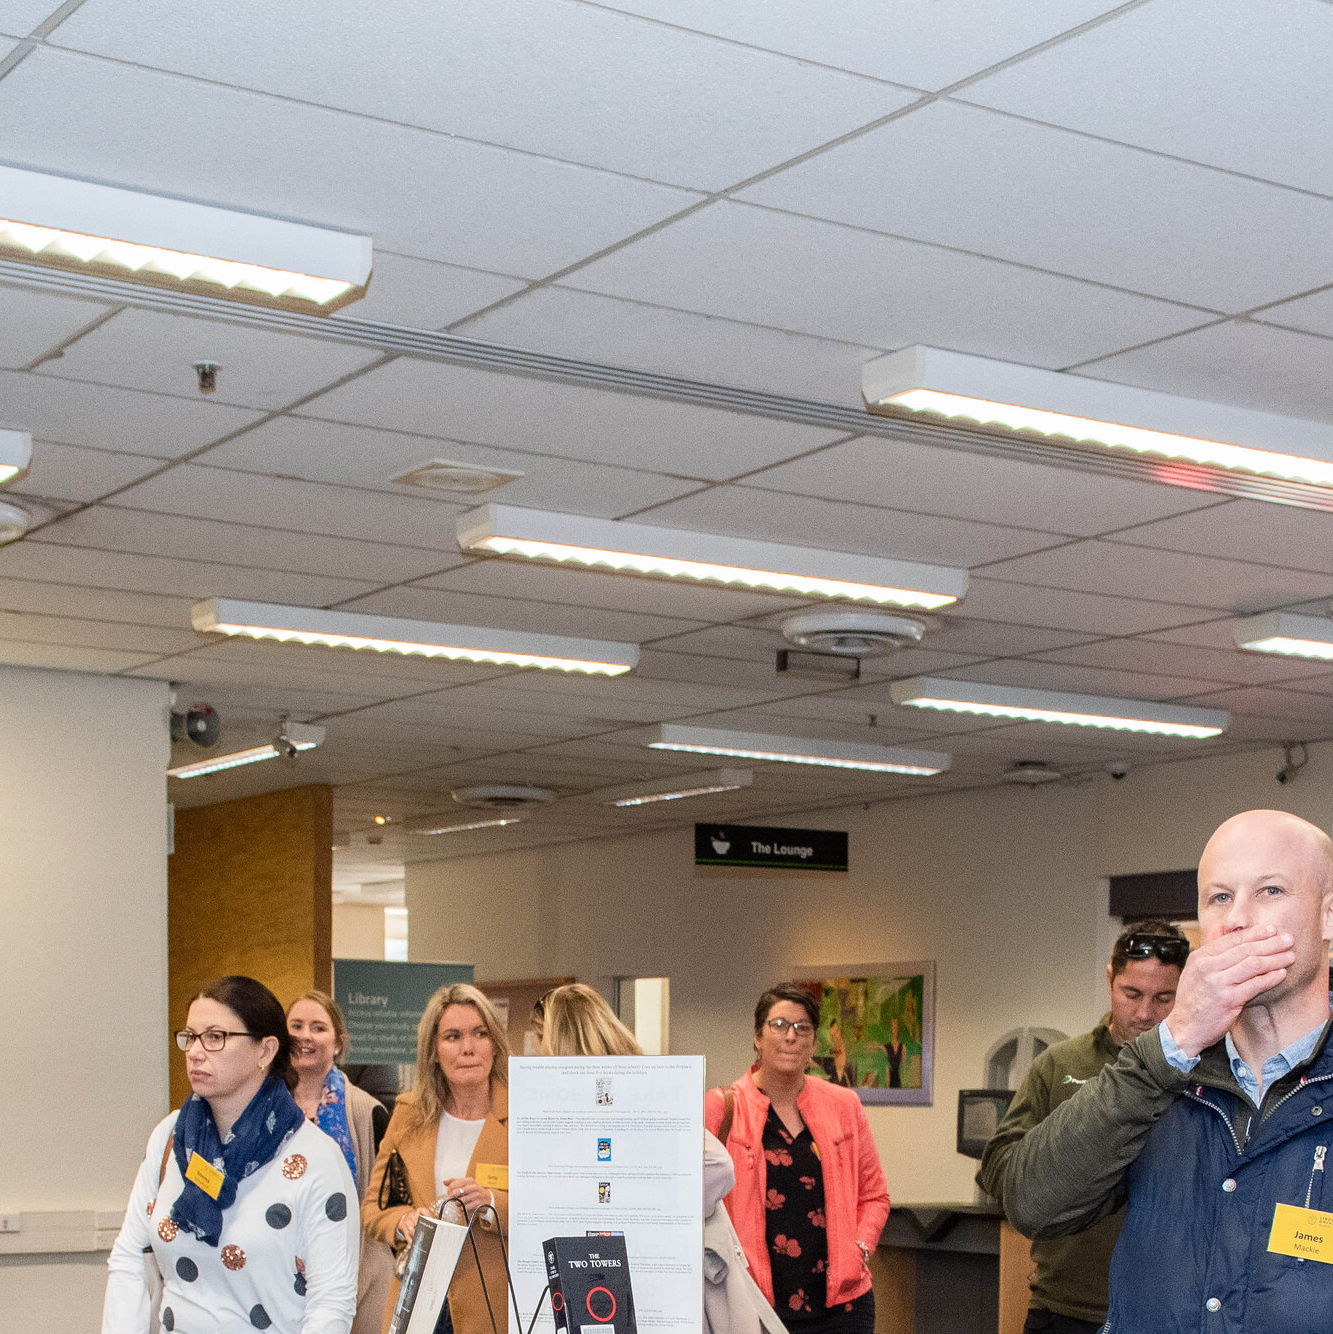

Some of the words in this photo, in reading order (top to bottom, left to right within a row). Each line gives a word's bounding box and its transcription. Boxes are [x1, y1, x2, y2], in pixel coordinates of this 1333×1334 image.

[751, 841, 771, 854] The
[773, 842, 813, 859] Lounge
[347, 992, 388, 1008] Library
[1294, 1230, 1324, 1244] James
[1293, 1242, 1321, 1255] Mackie
[568, 1260, 588, 1269] TWO
[591, 1259, 622, 1268] TOWERS
